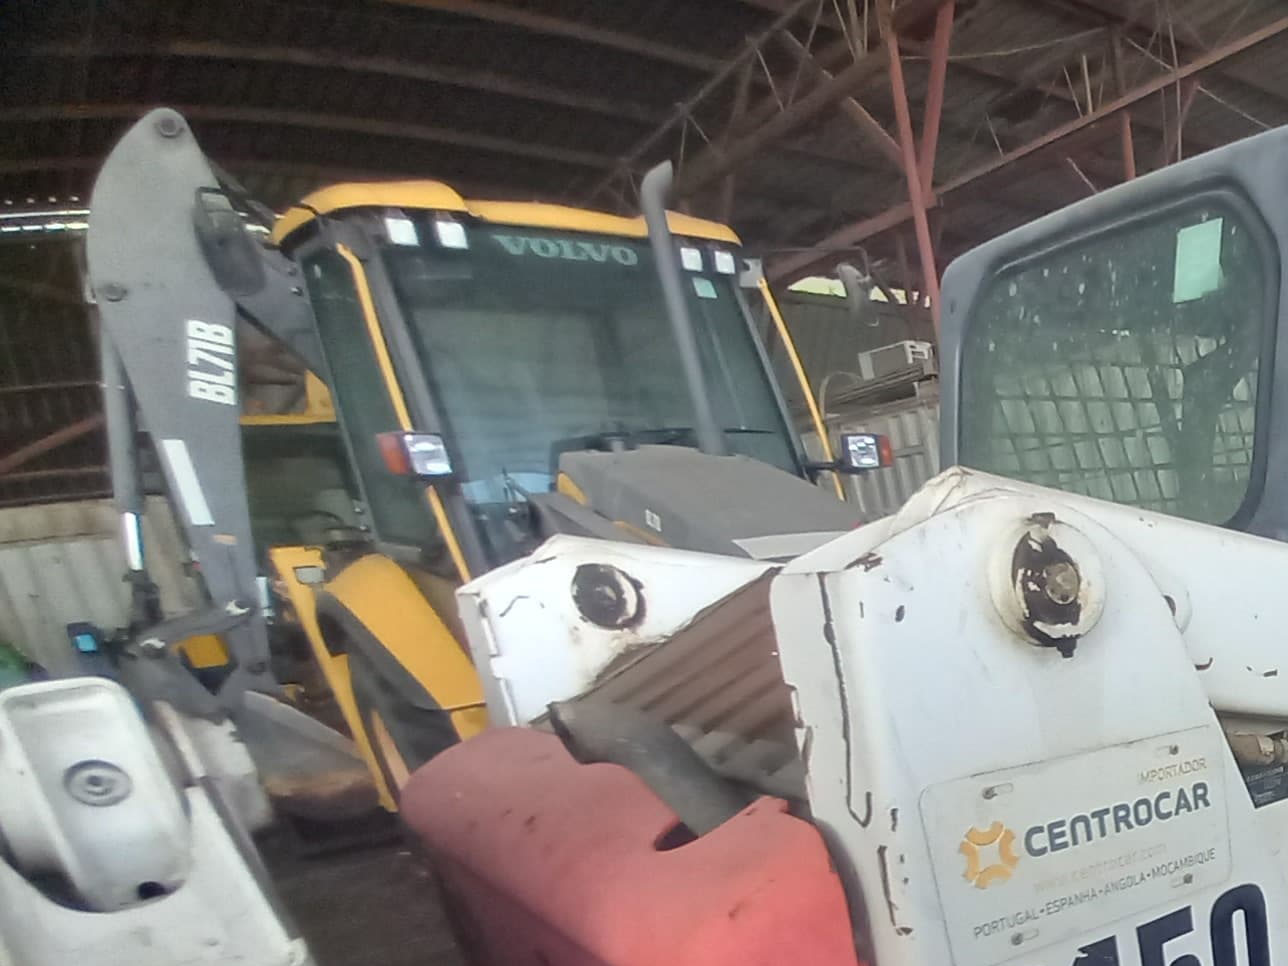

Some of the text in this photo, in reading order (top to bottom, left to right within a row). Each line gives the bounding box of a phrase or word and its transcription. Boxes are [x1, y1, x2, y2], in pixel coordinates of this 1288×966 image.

[492, 235, 638, 265] VOLVO
[187, 320, 237, 405] BL71B
[1024, 781, 1211, 857] CENTROCAR
